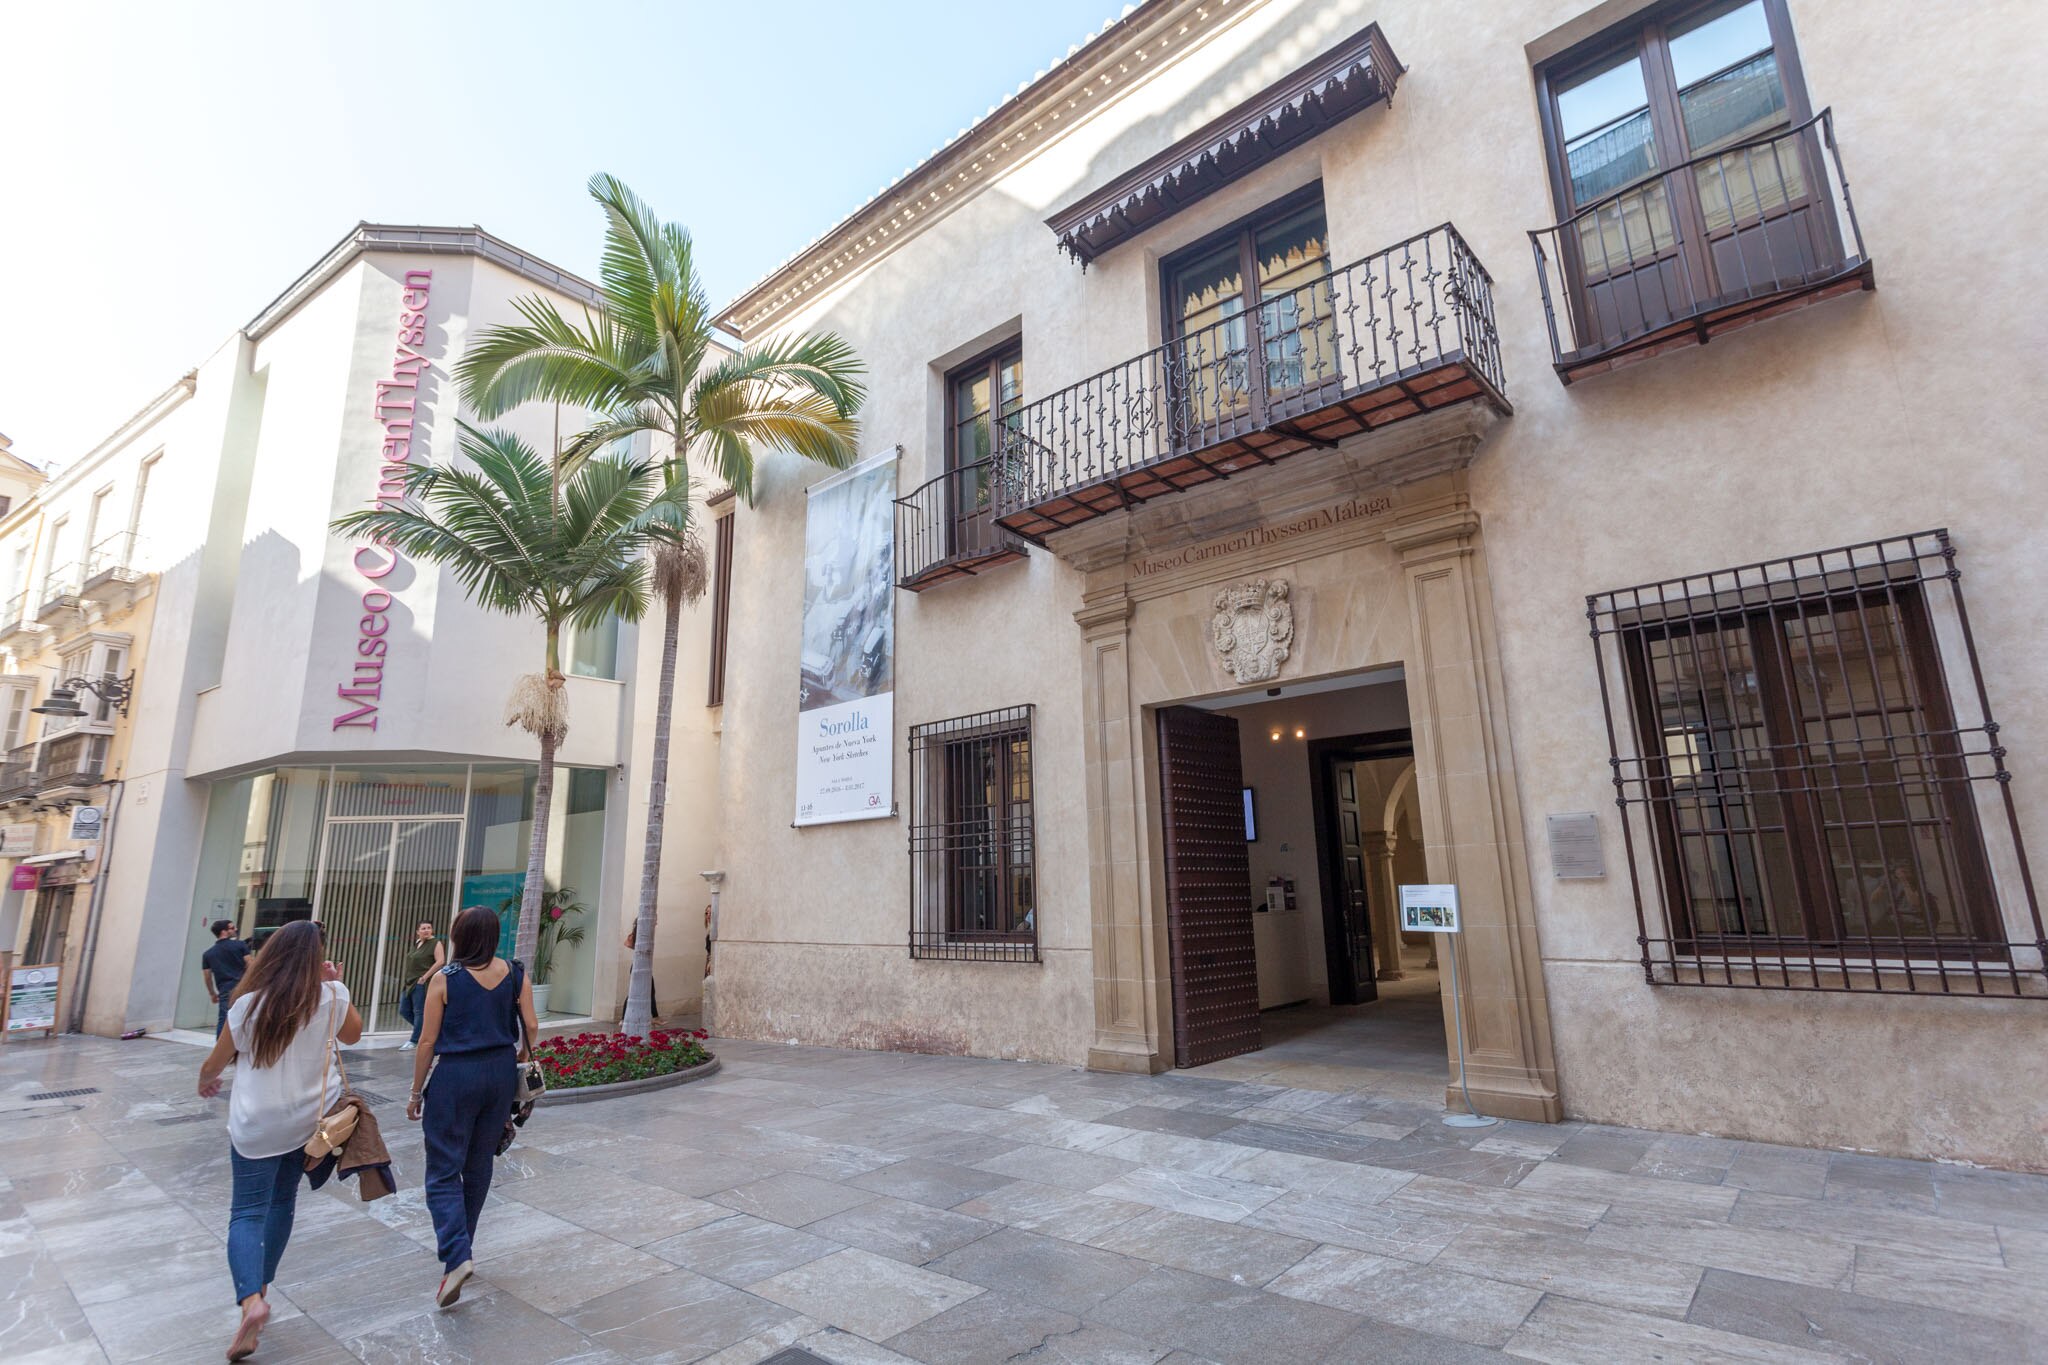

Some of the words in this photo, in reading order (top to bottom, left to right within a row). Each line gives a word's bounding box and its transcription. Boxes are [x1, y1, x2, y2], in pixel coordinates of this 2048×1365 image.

[1132, 556, 1182, 578] Museo
[1320, 495, 1393, 527] Málaga
[333, 588, 392, 733] Museo
[819, 711, 869, 738] Sorolla
[862, 733, 877, 744] York
